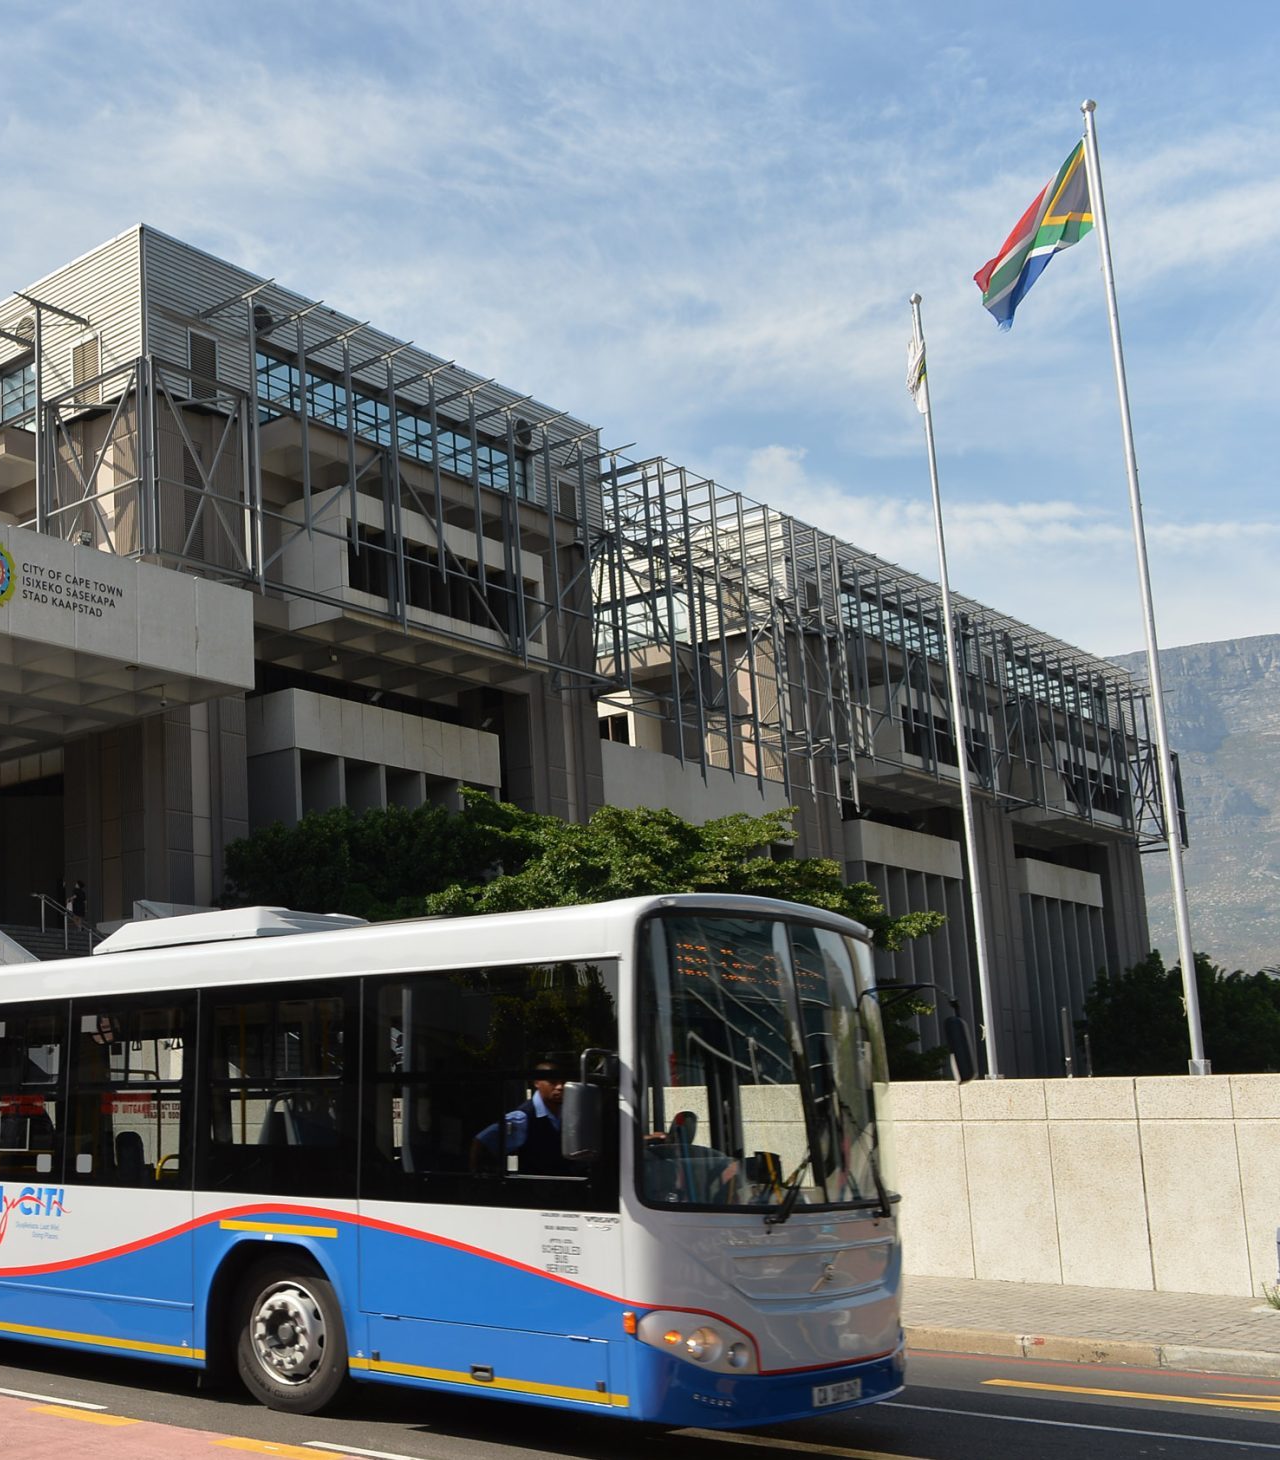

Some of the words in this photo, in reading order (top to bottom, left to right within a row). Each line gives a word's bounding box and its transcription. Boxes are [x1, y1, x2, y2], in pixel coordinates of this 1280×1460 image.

[22, 562, 45, 576] CITY
[48, 569, 62, 580] OF
[65, 574, 91, 589] CAPE
[93, 581, 123, 597] TOWN
[22, 576, 62, 594] ISIXEKO
[66, 587, 116, 608] SASEKAPA
[22, 589, 48, 604] STAD
[51, 596, 103, 617] KAAPSTAD
